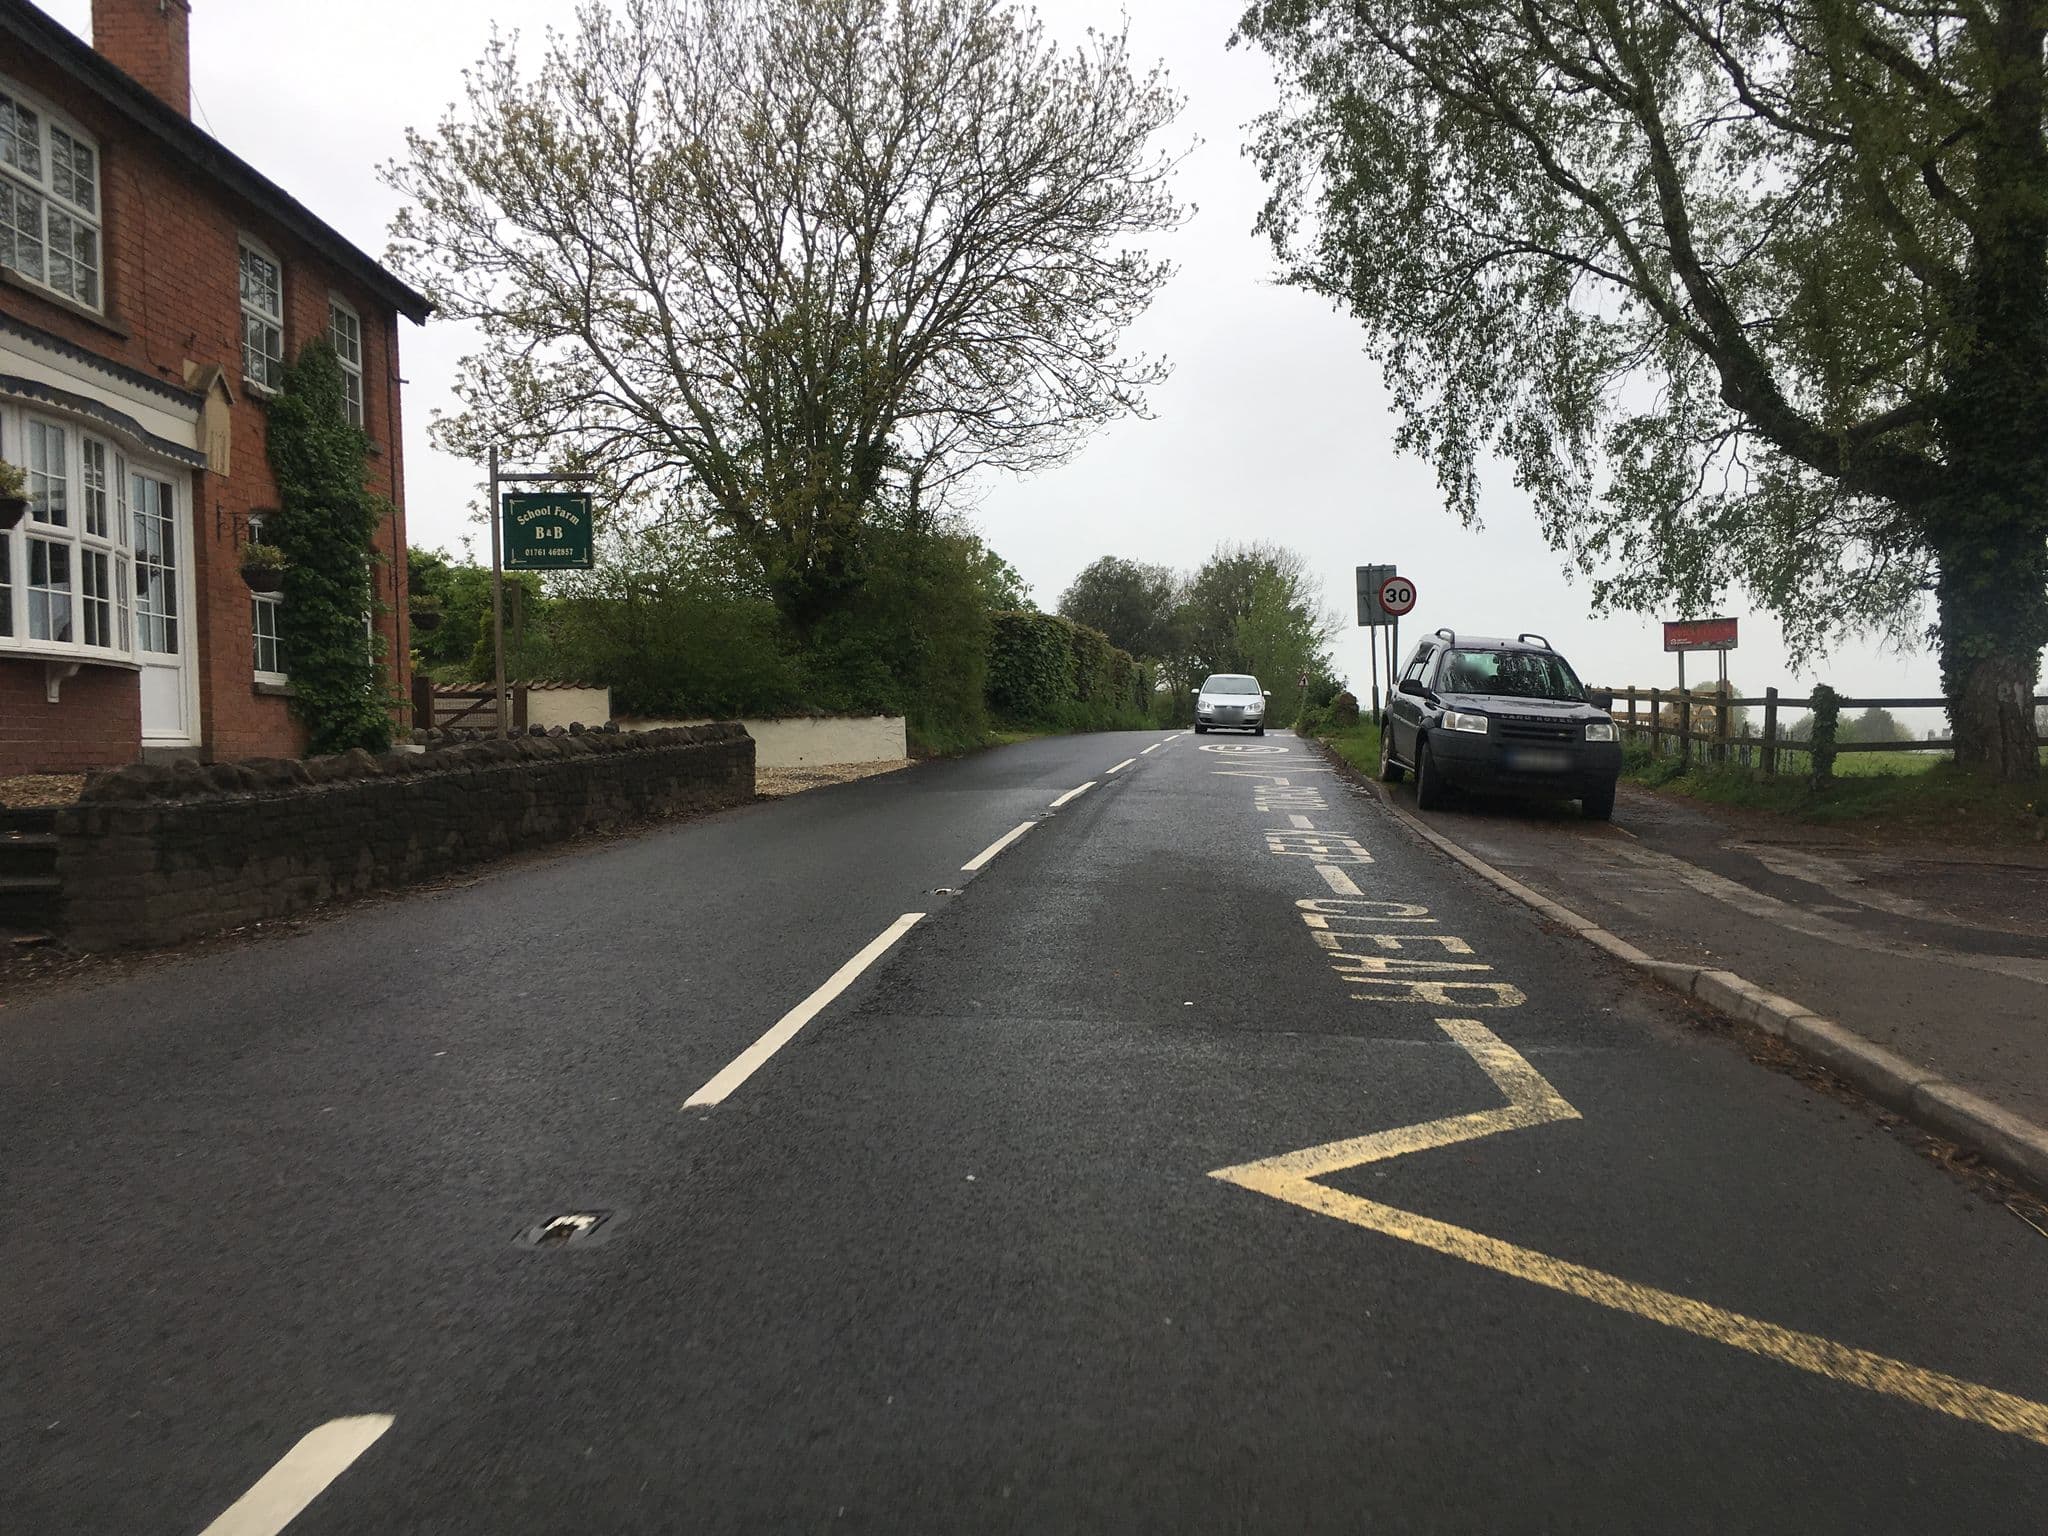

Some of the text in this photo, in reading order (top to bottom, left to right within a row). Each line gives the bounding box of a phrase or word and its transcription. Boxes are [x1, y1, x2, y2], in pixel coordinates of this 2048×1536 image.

[517, 505, 580, 525] School Farm
[525, 548, 546, 556] 01761
[1385, 588, 1410, 603] 30
[1263, 828, 1376, 863] KEEP
[1295, 898, 1528, 1008] CLEAR
